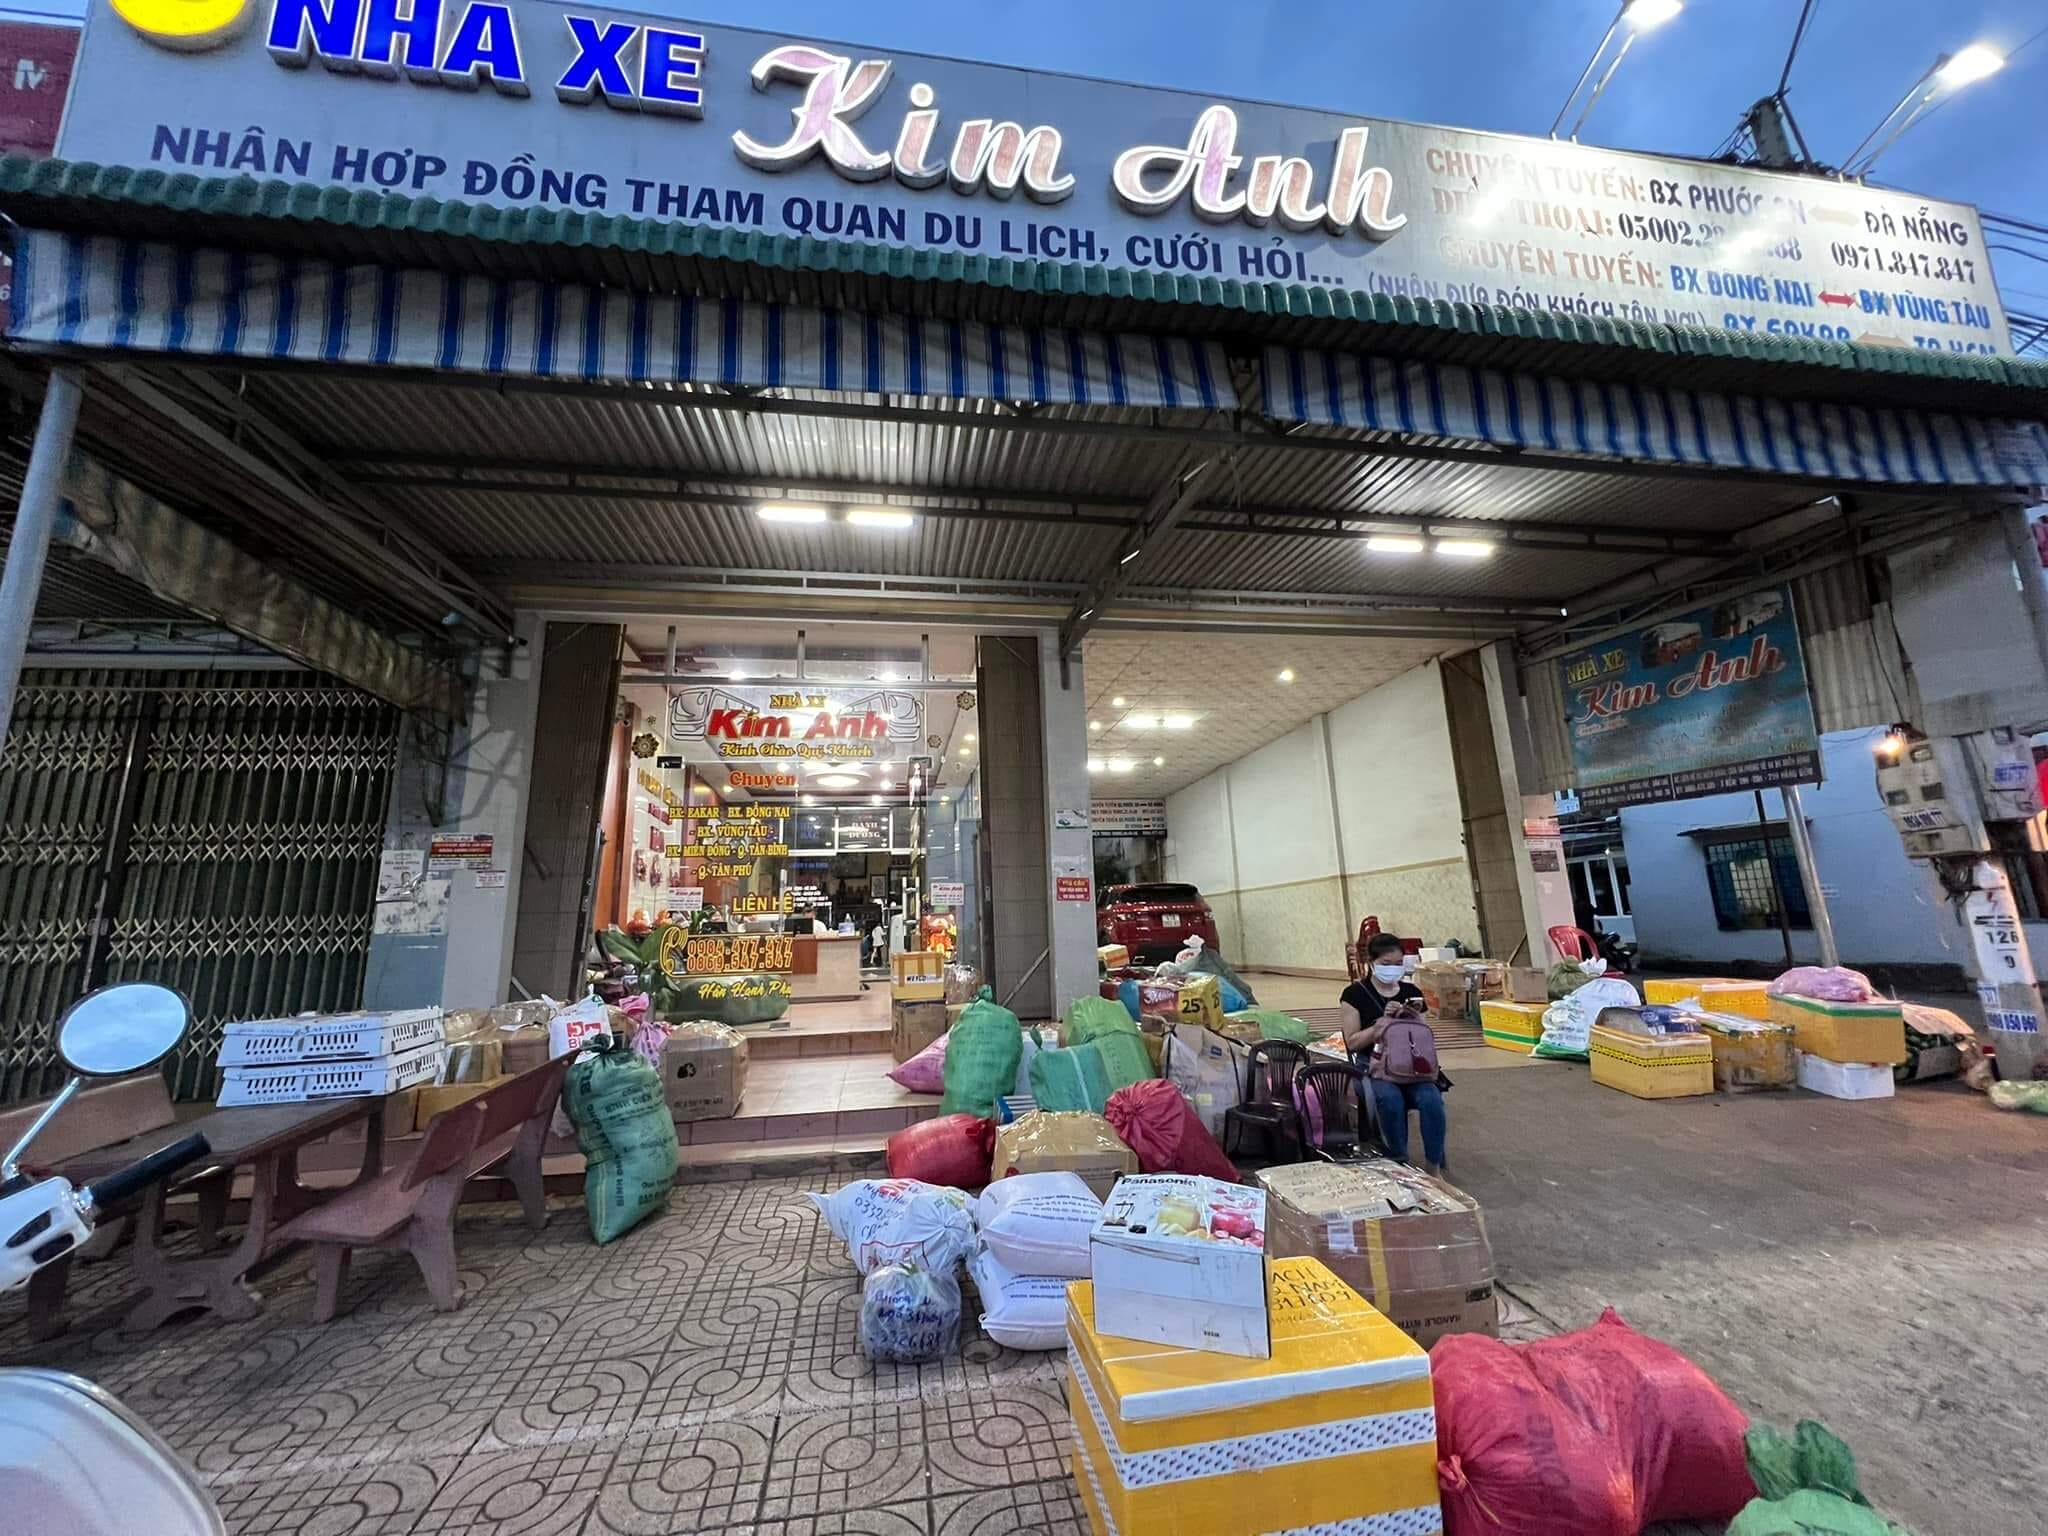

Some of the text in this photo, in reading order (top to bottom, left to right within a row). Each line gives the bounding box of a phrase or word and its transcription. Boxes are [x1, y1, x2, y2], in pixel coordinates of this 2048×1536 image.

[553, 14, 704, 108] XE
[731, 45, 1407, 237] Kim Anh
[331, 147, 447, 194] HỢP
[463, 152, 608, 210] ĐỒNG
[625, 178, 764, 226] THAM
[782, 197, 906, 243] QUAN
[924, 211, 981, 249] DU
[1125, 232, 1222, 273] CƯỚI
[1238, 236, 1344, 285] HỎI...
[1649, 179, 1682, 208] BX
[1864, 205, 1896, 237] ĐÀ
[1902, 206, 1969, 247] NẴNG
[1564, 250, 1664, 289] TUYẾN:
[1774, 278, 1814, 307] NAI
[1860, 288, 1889, 316] BX
[1894, 290, 1948, 324] VŨNG
[1950, 297, 1990, 330] TÀU
[1831, 241, 1976, 285] 0971.847.847
[1567, 650, 1625, 684] NHÀ XE
[1572, 633, 1787, 724] Kim Anh
[706, 708, 889, 741] Kim Anh
[718, 742, 758, 758] Kính
[732, 890, 769, 912] LIÊN
[1182, 998, 1201, 1014] 25
